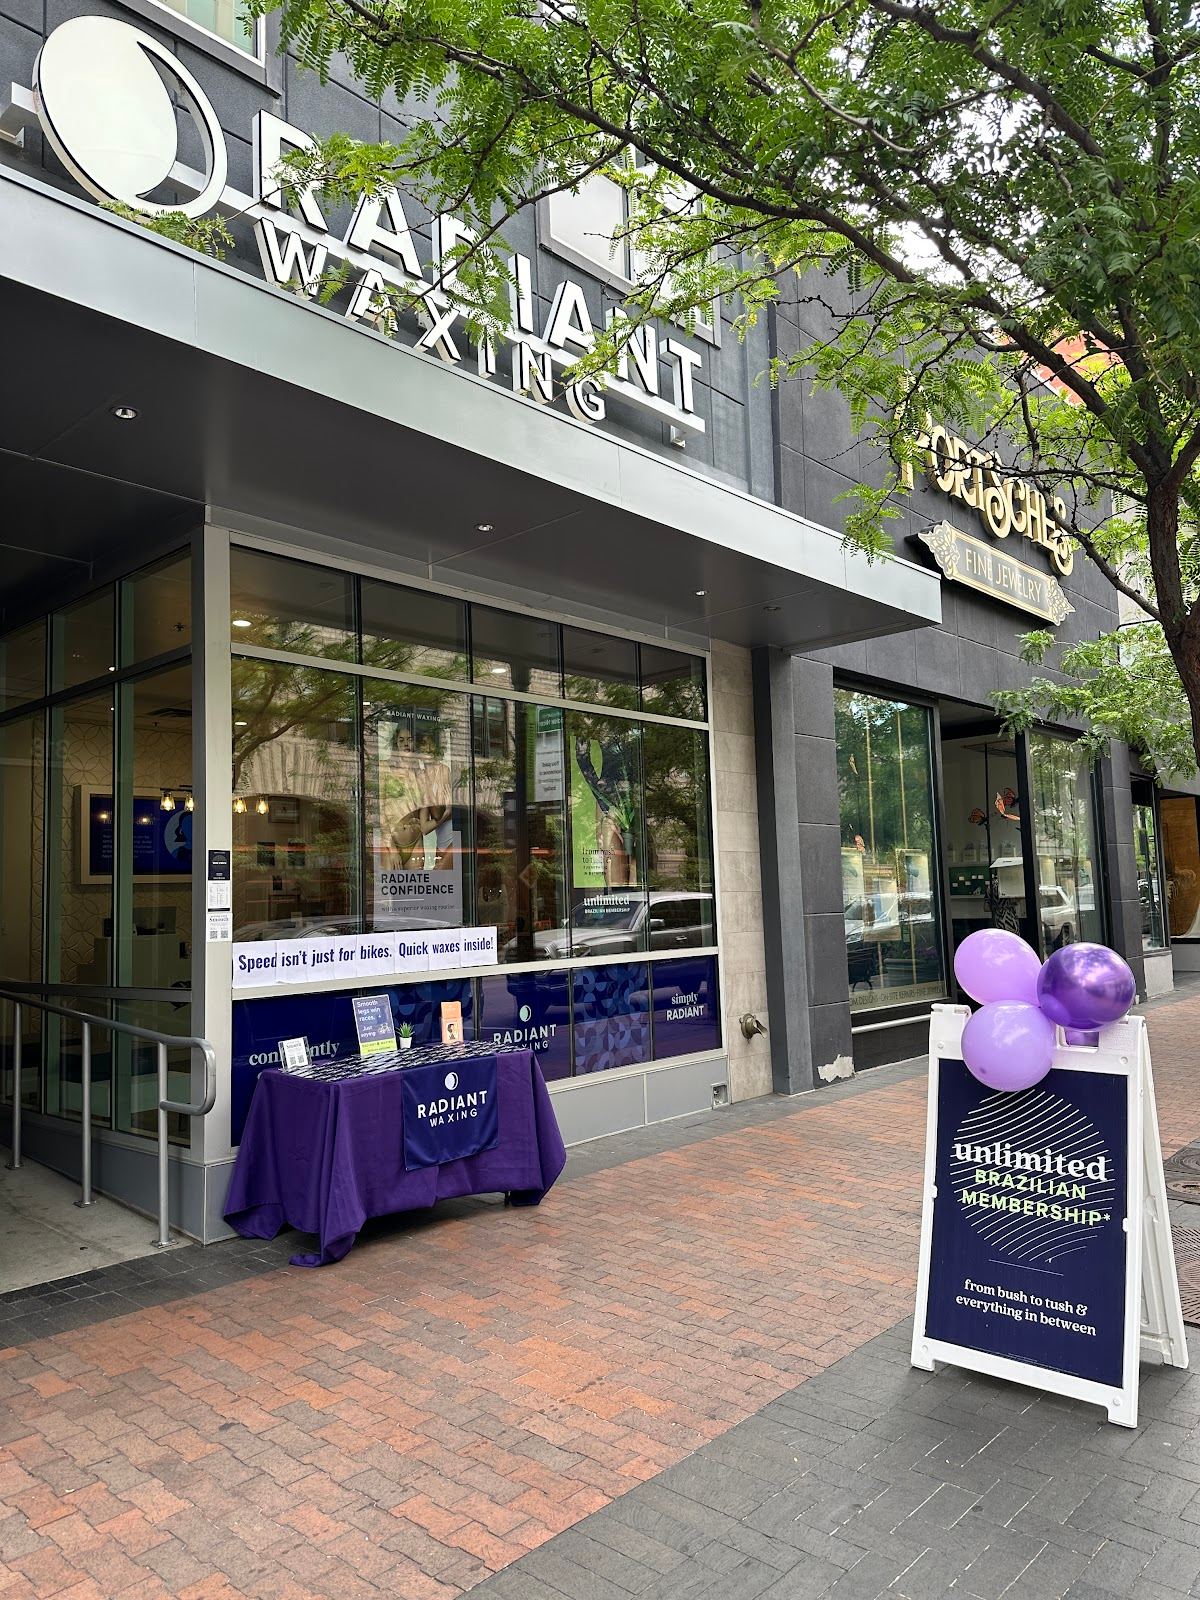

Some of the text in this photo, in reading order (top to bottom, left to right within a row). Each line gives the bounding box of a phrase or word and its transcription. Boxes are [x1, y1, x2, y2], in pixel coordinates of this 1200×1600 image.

[252, 109, 704, 414] RADIANT
[252, 217, 607, 424] WAXING
[965, 548, 1042, 603] FINE JEWELRY
[386, 710, 441, 722] RADIANT WAXING
[381, 873, 430, 884] RADIATE
[381, 884, 454, 896] CONFIDENCE
[583, 894, 630, 906] unlimited
[238, 937, 494, 973] Speed isn't just for bikes. Quick waxes inside!
[671, 991, 699, 1006] simply
[666, 1005, 704, 1021] RADIANT
[493, 1023, 557, 1044] RADIANT
[248, 1040, 340, 1066] conntly
[417, 1090, 487, 1119] RADIANT
[430, 1108, 478, 1128] WAXING
[953, 1142, 1108, 1183] unlimited
[975, 1168, 1087, 1201] BRAZILIAN
[964, 1278, 1089, 1317] from bush to tush &
[955, 1295, 1097, 1337] everything in between
